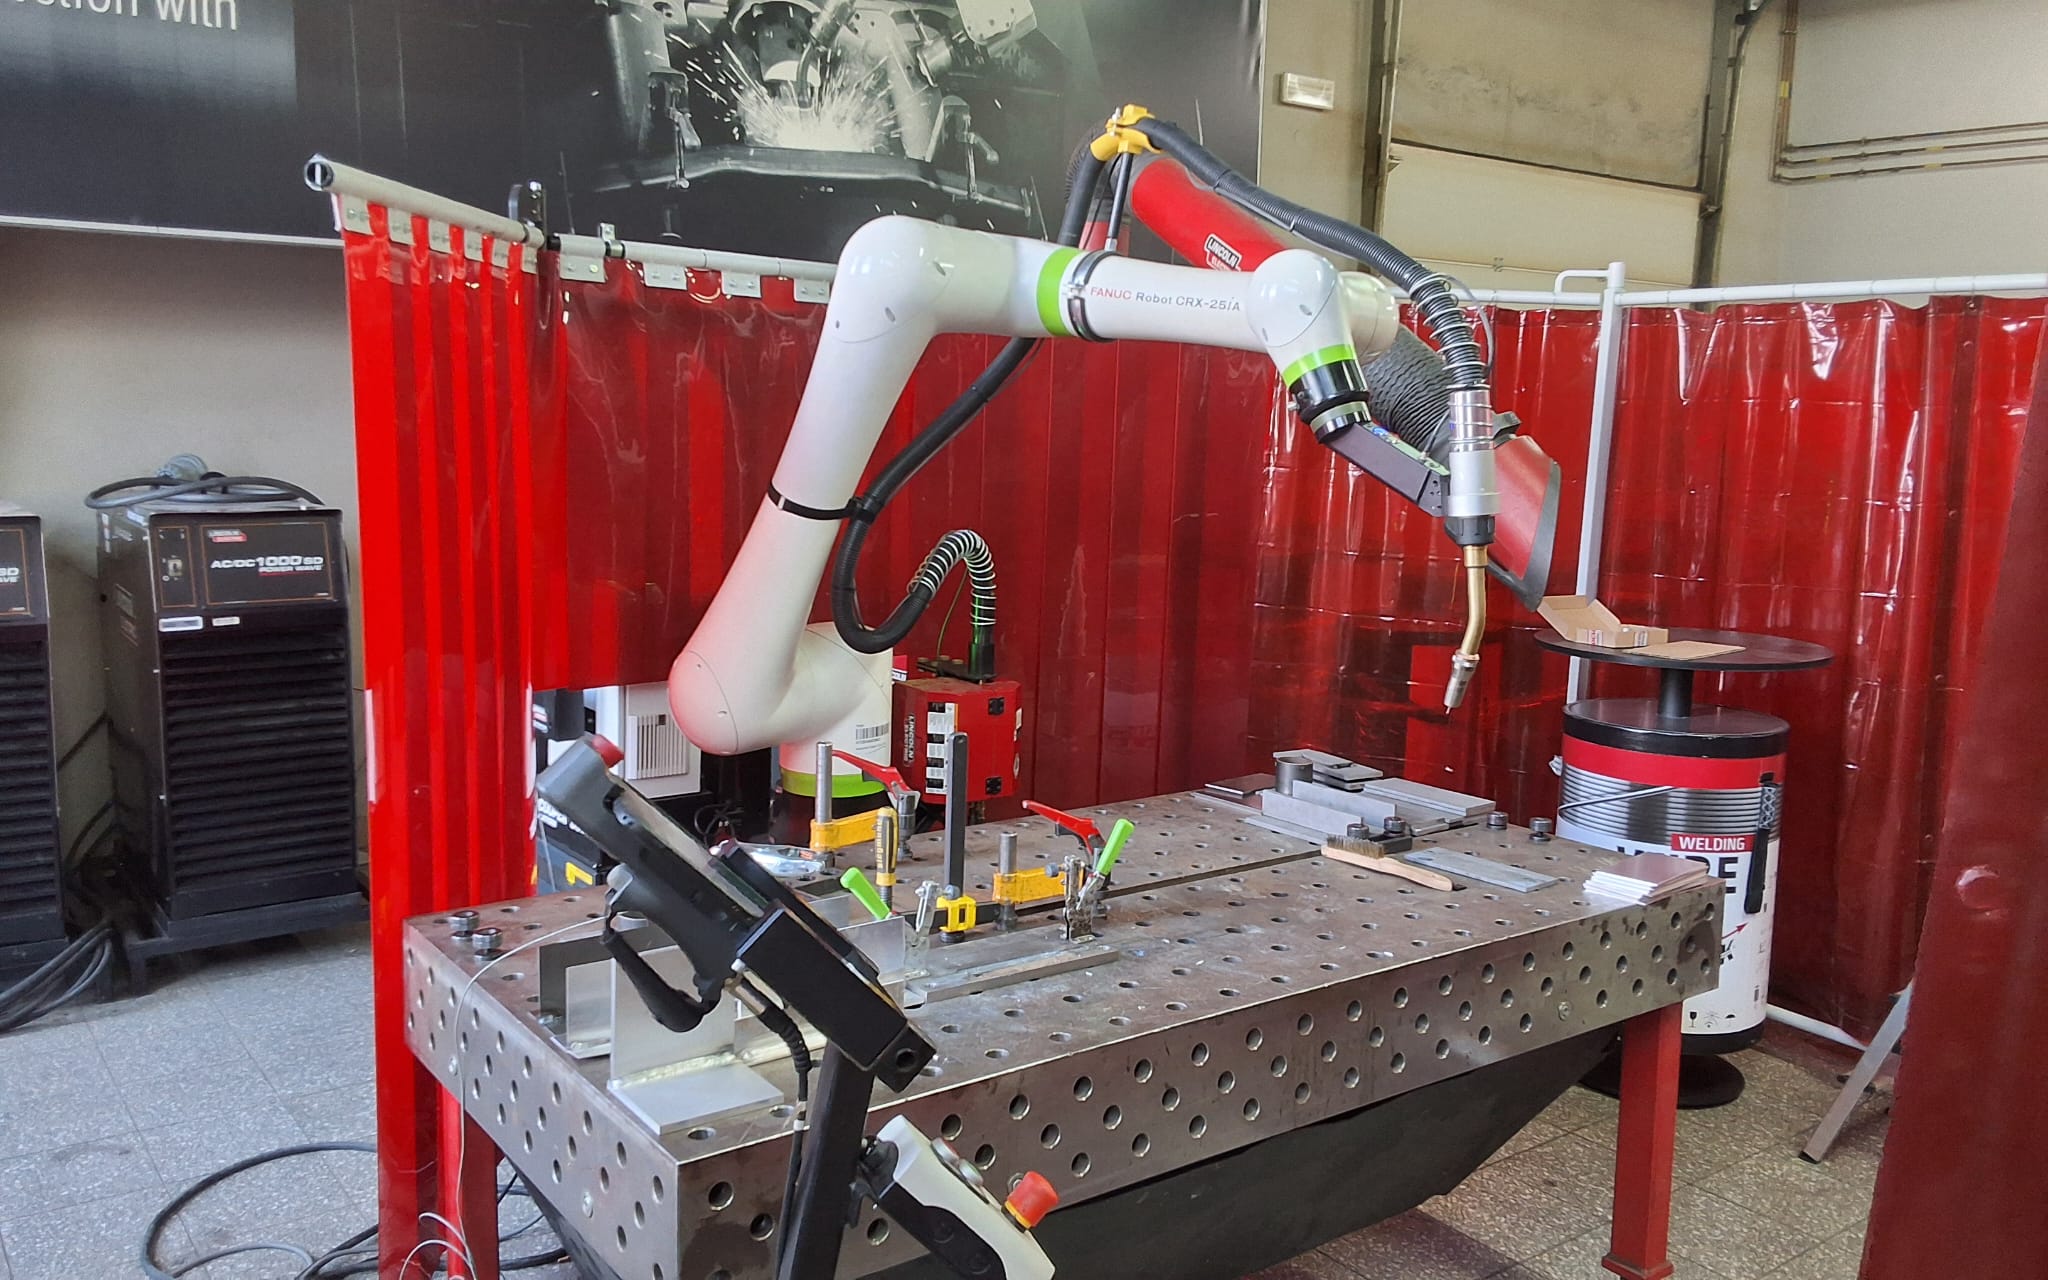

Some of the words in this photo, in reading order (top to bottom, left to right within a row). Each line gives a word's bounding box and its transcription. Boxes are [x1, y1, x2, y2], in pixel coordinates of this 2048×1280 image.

[152, 0, 238, 31] with
[1207, 238, 1239, 269] LINCOLN
[1089, 286, 1132, 300] FANUC
[1135, 291, 1173, 305] Robot
[908, 714, 916, 760] LINCOLN
[1678, 835, 1746, 851] WELDING
